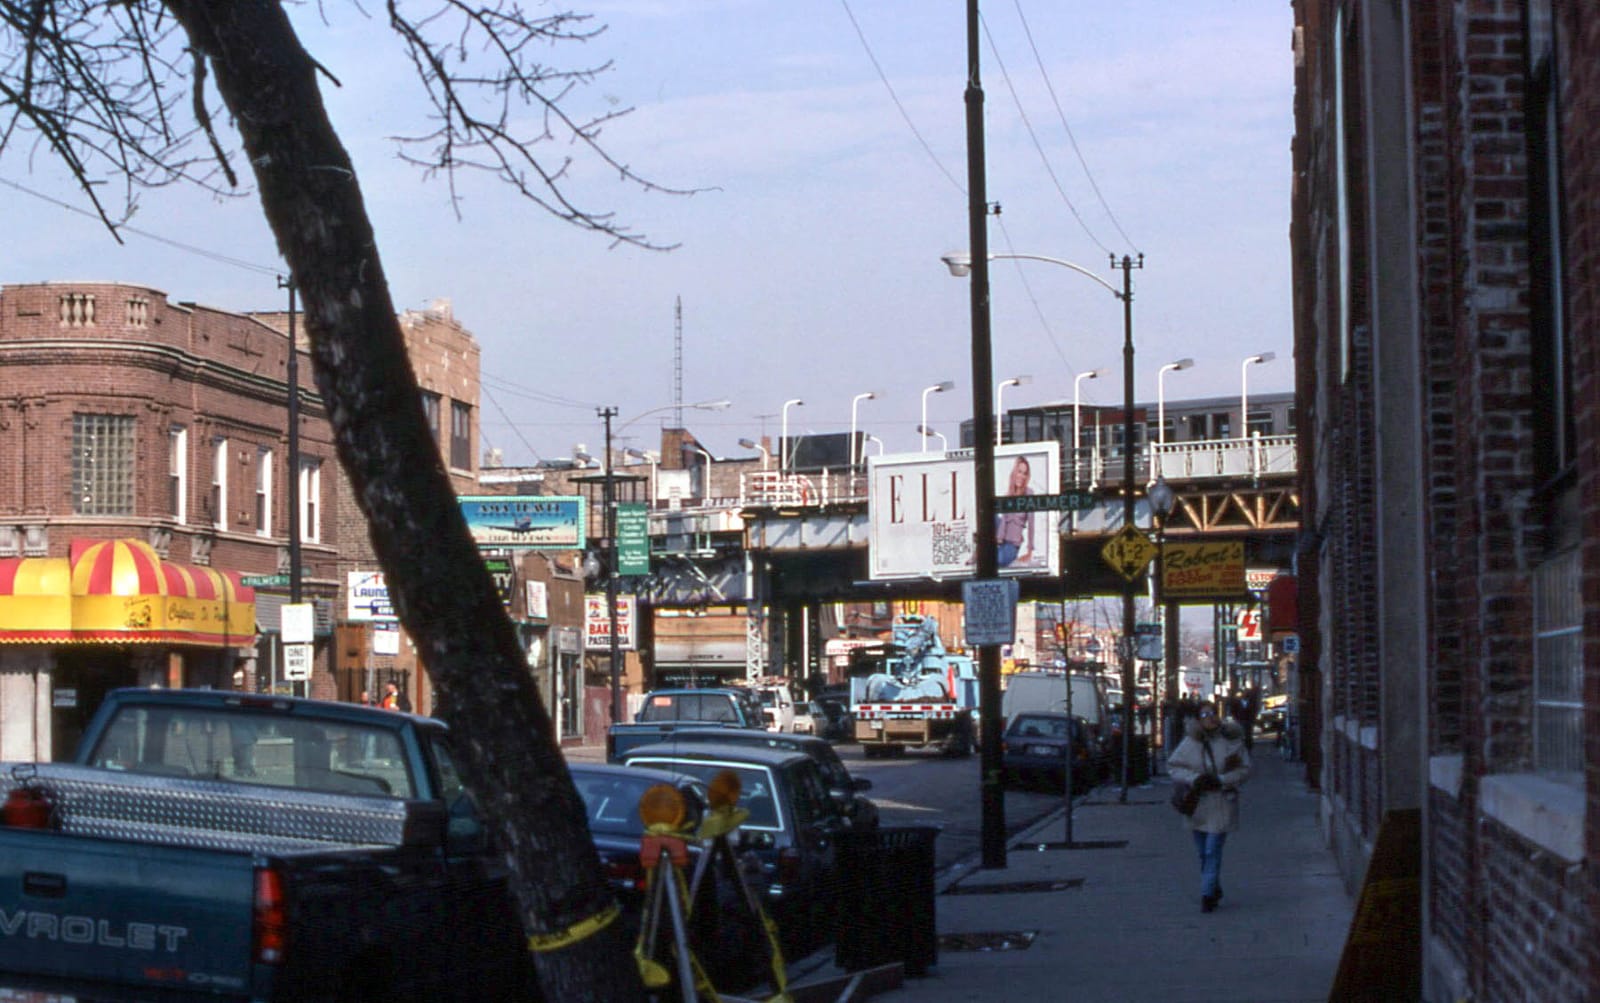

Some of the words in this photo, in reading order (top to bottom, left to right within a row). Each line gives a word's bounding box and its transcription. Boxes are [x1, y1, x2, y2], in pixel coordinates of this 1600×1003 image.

[889, 471, 966, 524] ELL
[1016, 495, 1080, 511] PALMER
[932, 543, 971, 555] FASHION
[247, 576, 280, 587] PALMER
[492, 573, 512, 588] TY
[589, 623, 629, 635] BAKRY
[588, 636, 630, 645] PASTERIA
[288, 648, 304, 657] ONE
